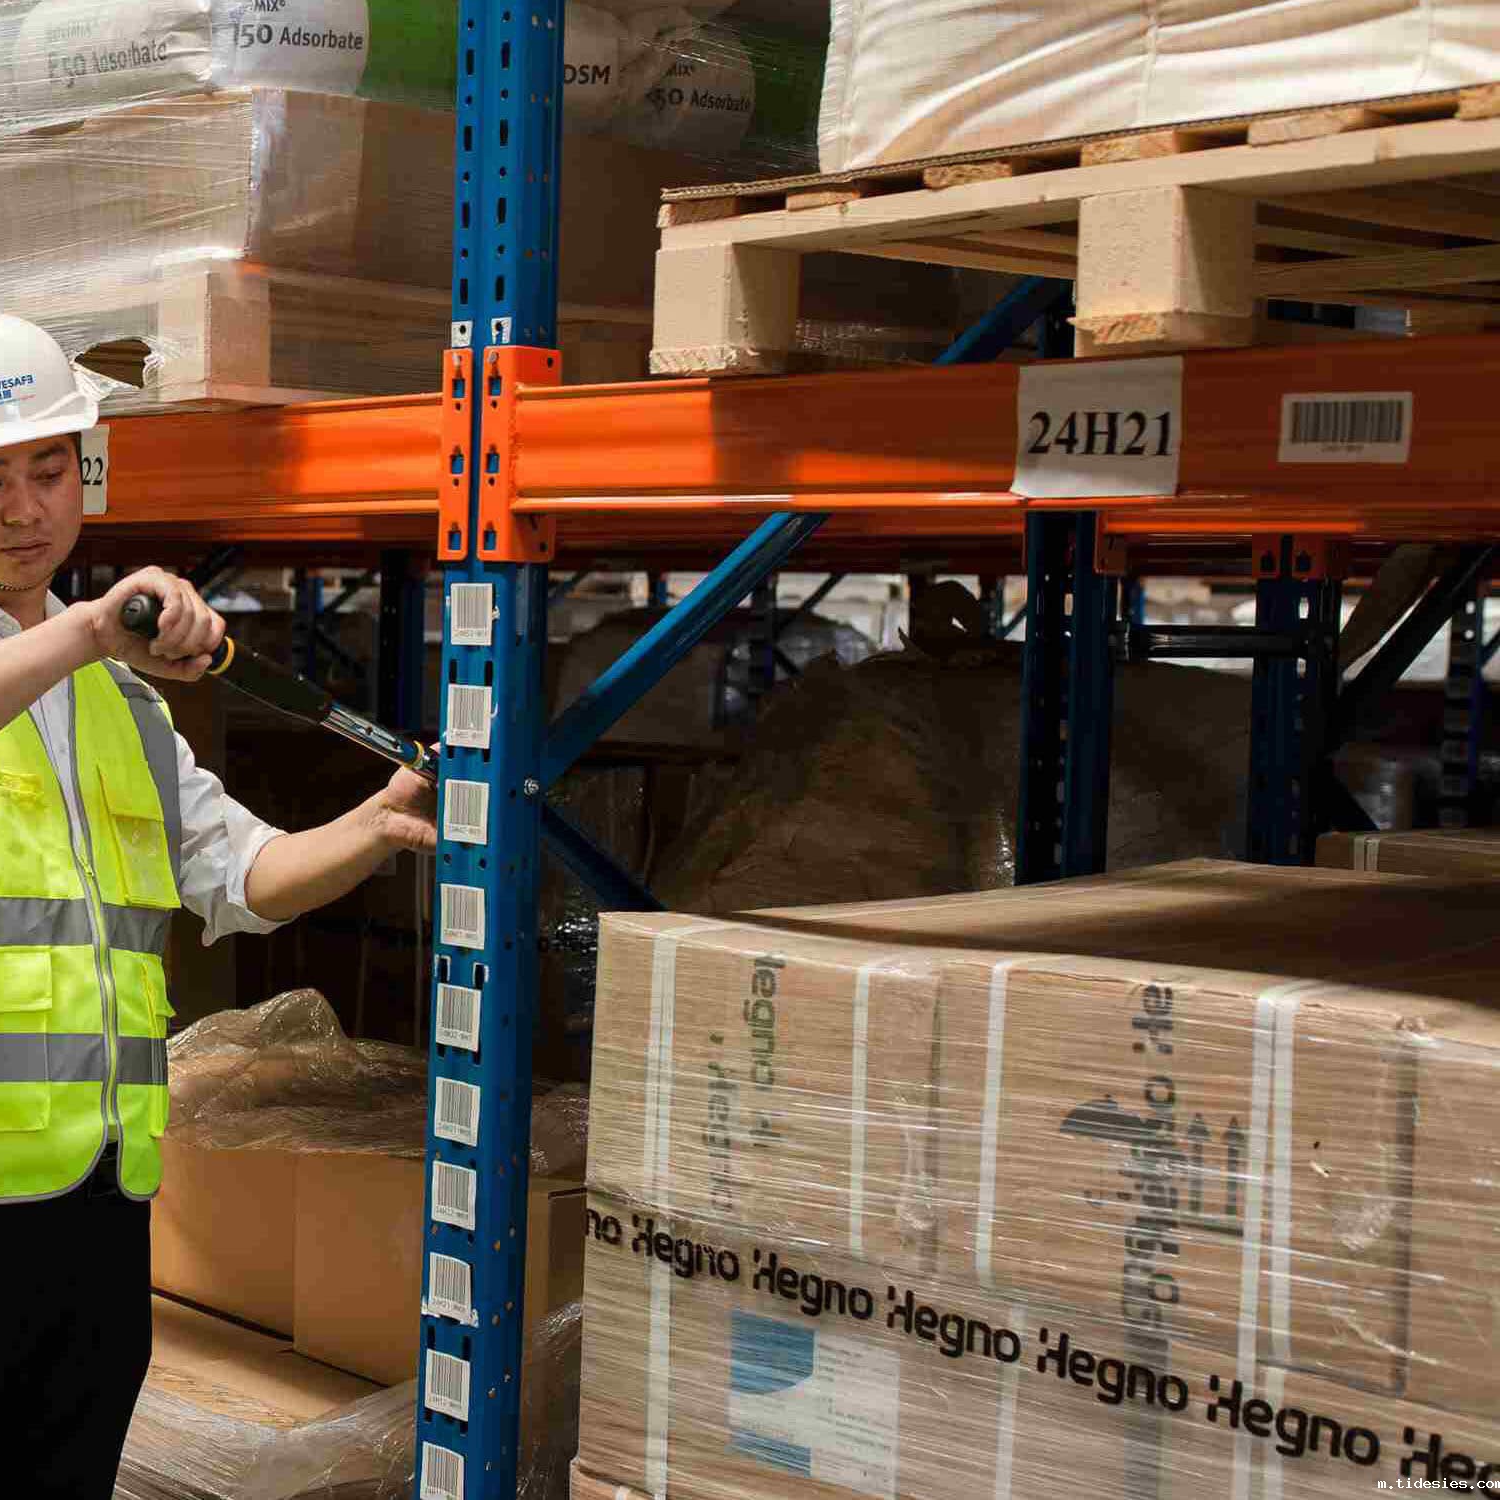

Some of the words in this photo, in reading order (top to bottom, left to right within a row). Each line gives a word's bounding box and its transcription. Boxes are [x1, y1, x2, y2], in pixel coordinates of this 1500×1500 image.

[279, 26, 364, 51] Adsorbate
[563, 63, 611, 85] DSM
[1027, 410, 1173, 456] 24H21
[631, 1213, 740, 1281] Hegno
[752, 1249, 874, 1320] Hegno
[886, 1285, 1021, 1363] Hegno
[1037, 1327, 1189, 1411] Hegno
[1206, 1374, 1380, 1466] Hegno
